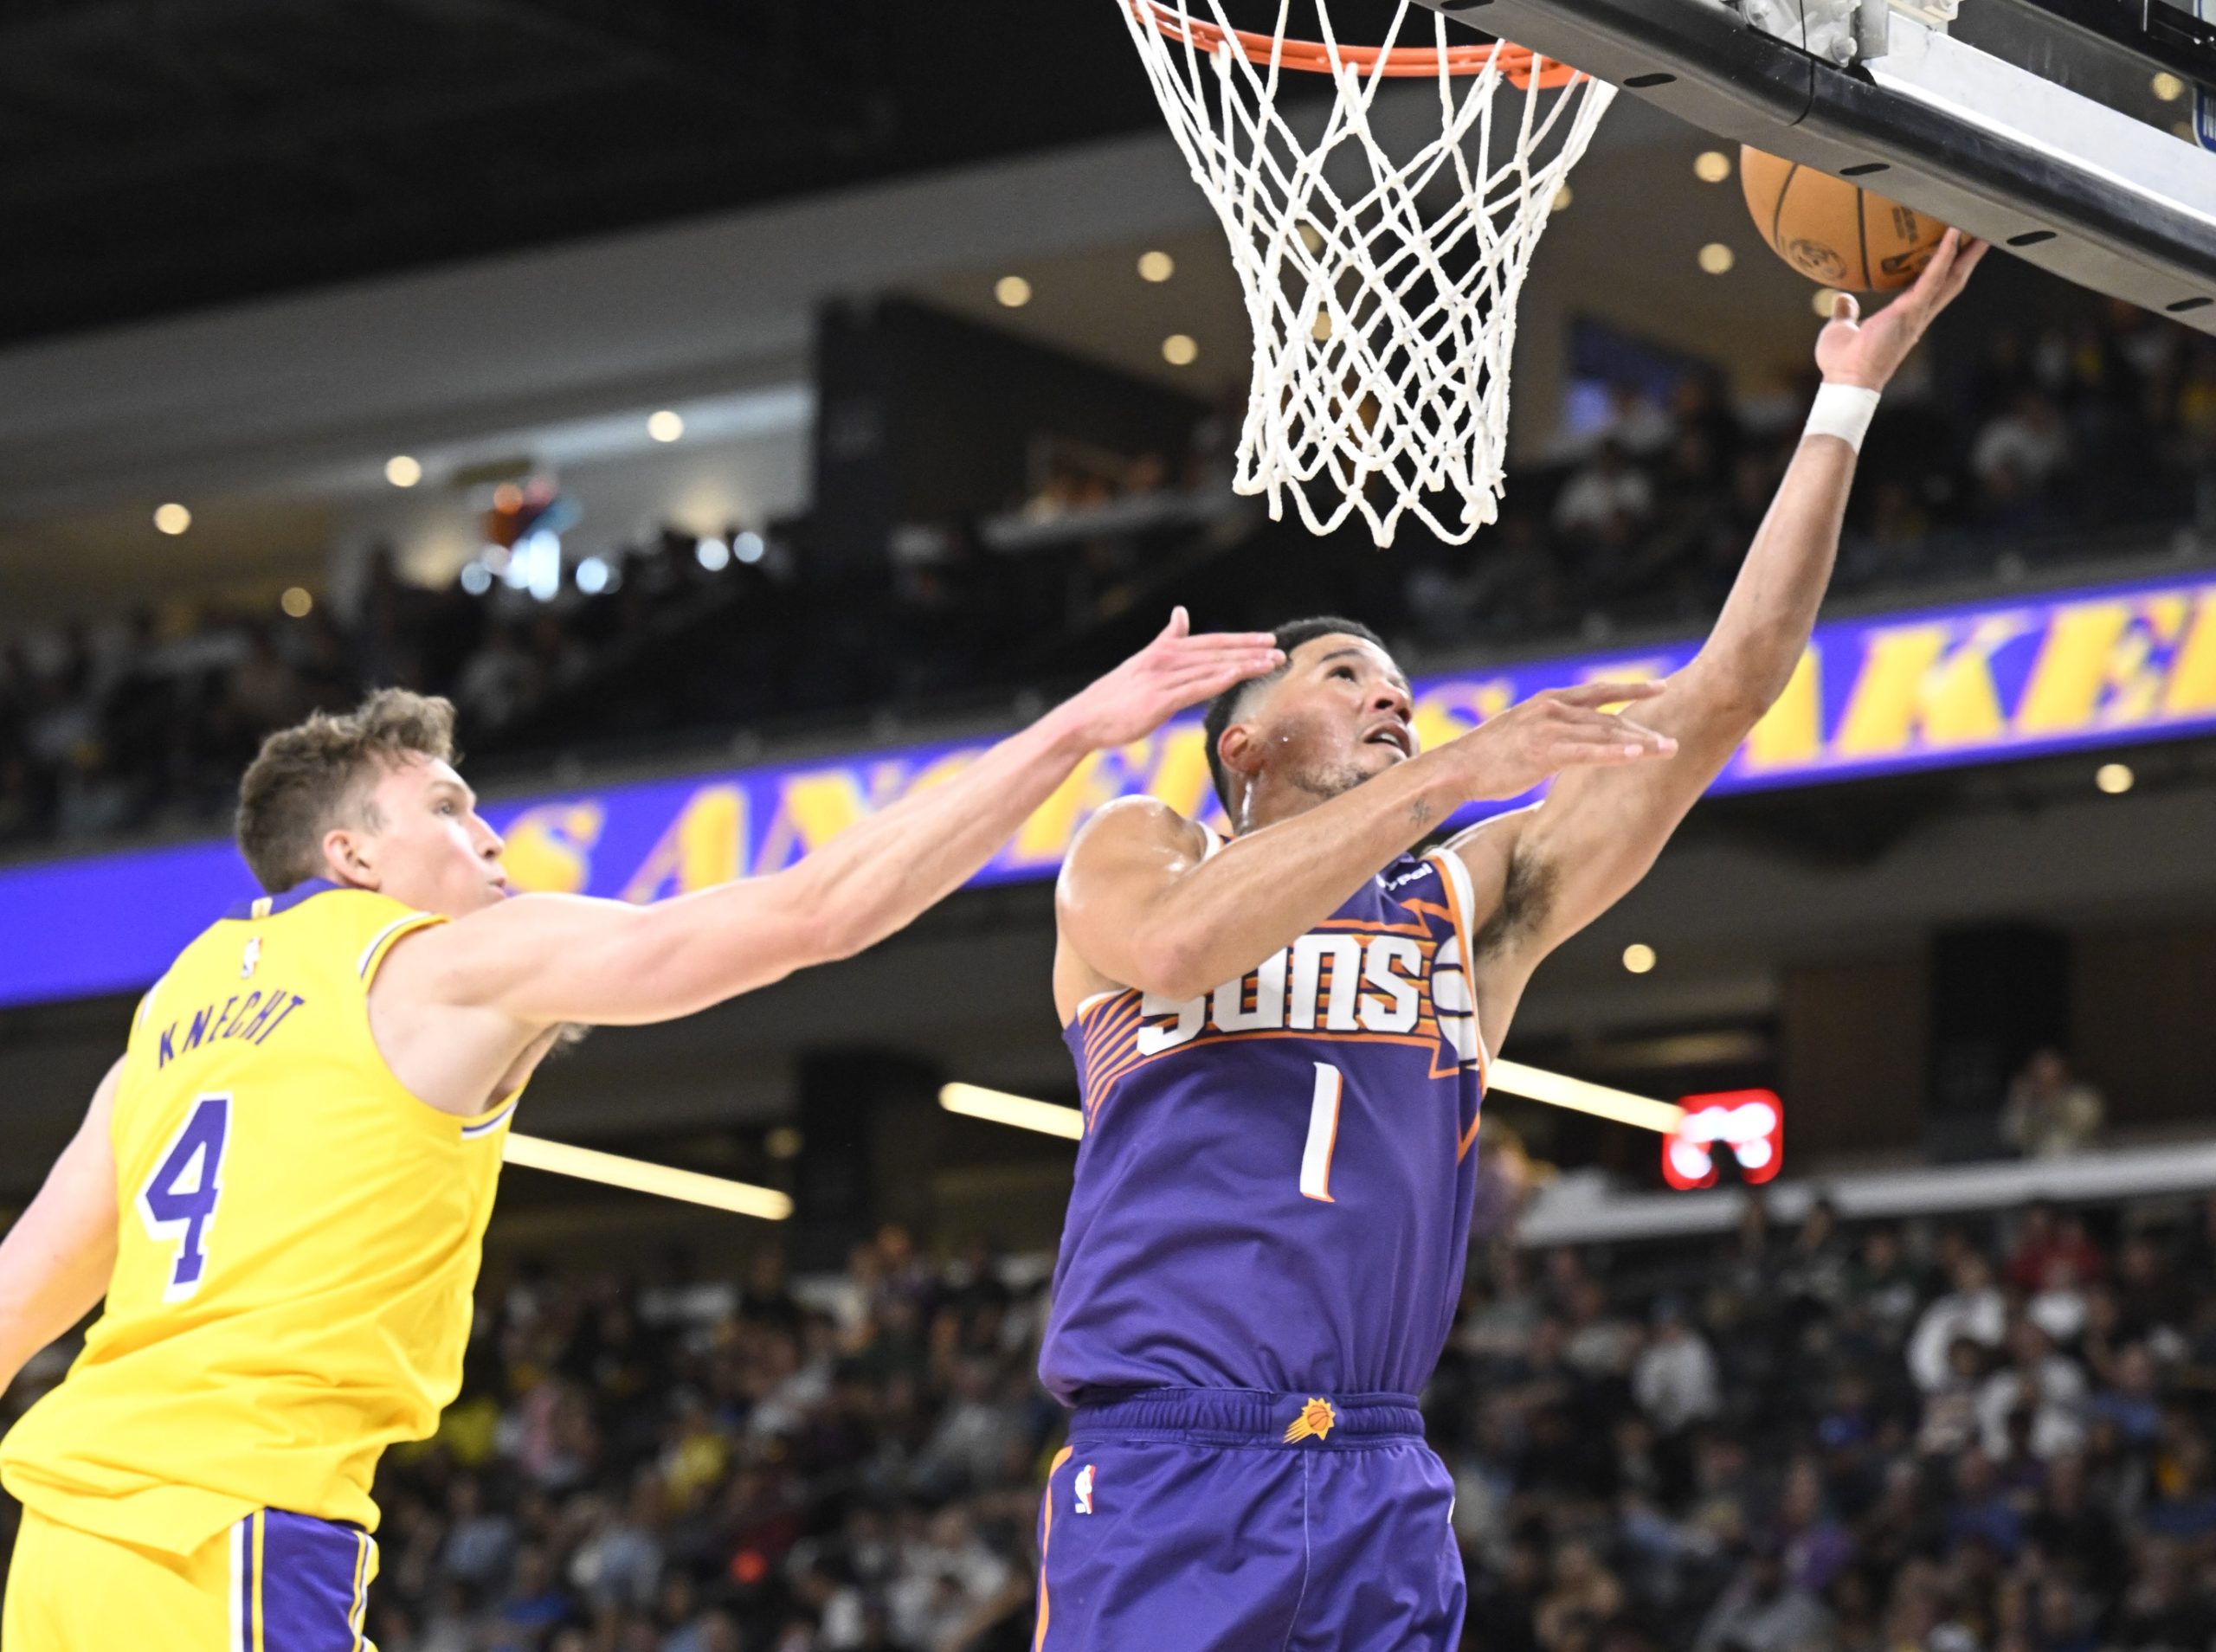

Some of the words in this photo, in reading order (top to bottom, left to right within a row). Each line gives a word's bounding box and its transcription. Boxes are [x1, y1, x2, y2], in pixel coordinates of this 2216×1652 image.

[158, 988, 306, 1071] KNECHT
[134, 1090, 235, 1304] 4
[1299, 1061, 1343, 1203] 1
